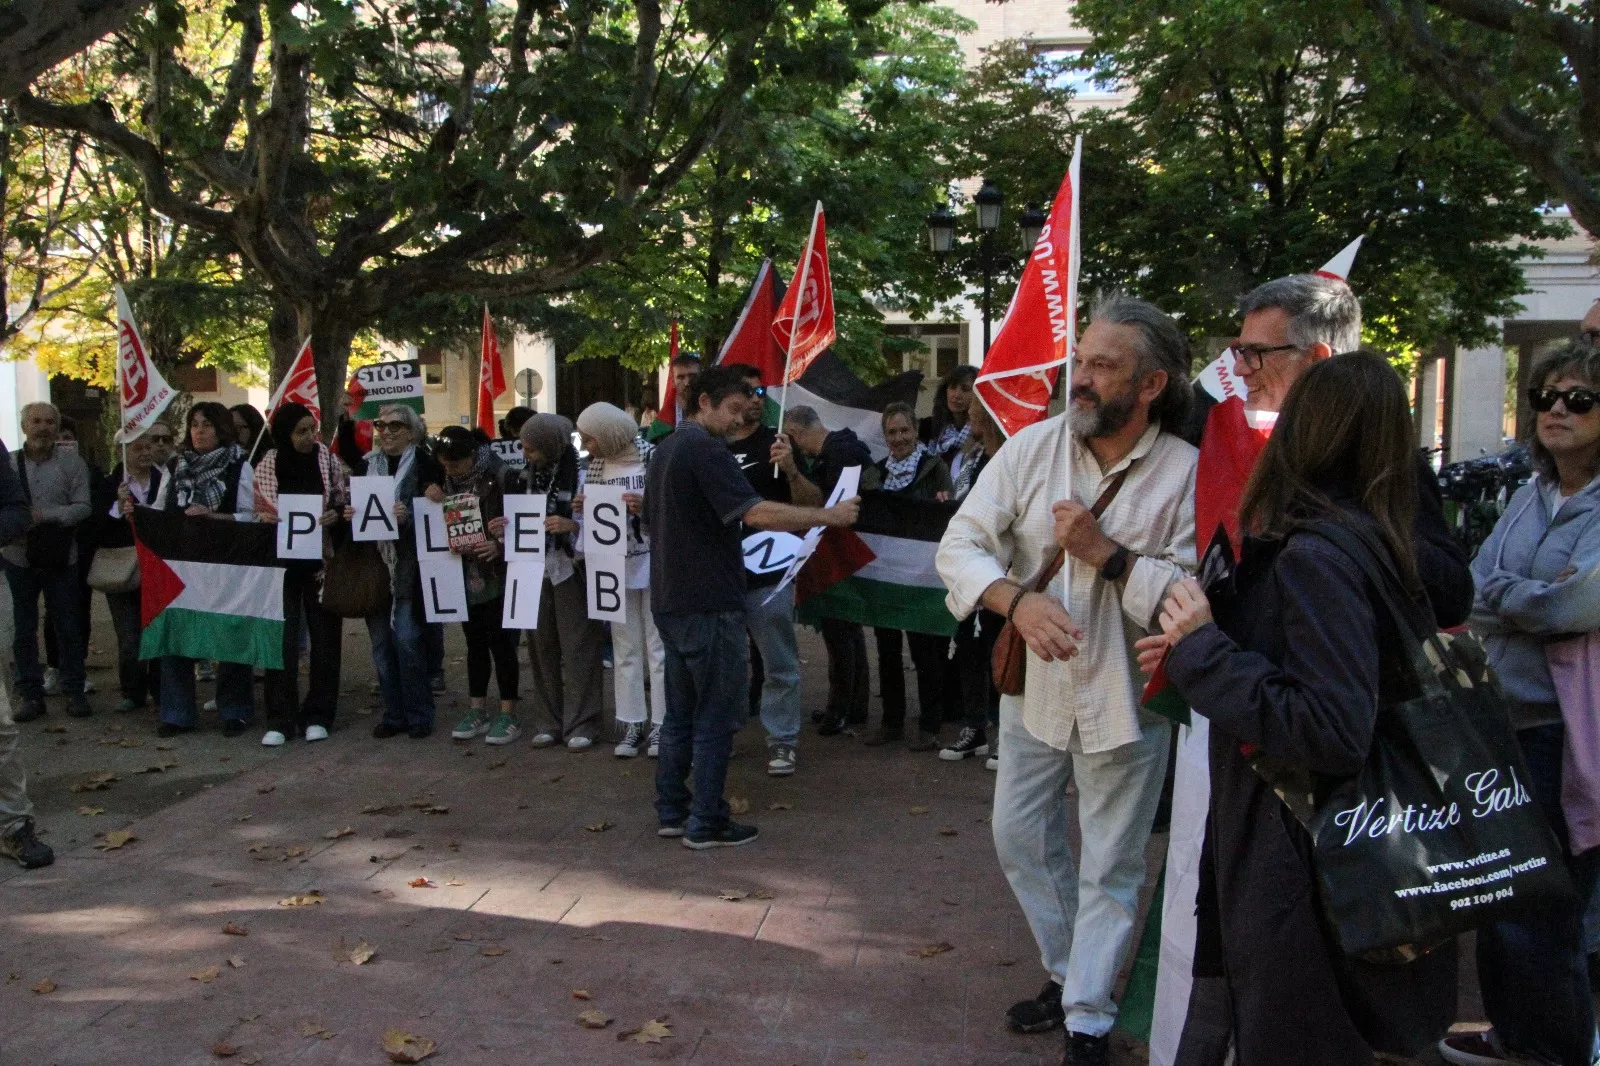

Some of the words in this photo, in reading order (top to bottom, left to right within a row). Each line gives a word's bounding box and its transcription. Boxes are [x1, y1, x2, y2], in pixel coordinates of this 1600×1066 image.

[358, 363, 412, 383] STOP
[489, 439, 526, 454] STO
[286, 511, 316, 550] P
[359, 493, 395, 533] A
[423, 514, 450, 553] L
[514, 512, 541, 554] E
[592, 502, 621, 546] S
[449, 520, 483, 537] STOP
[430, 577, 458, 615] L
[595, 570, 622, 613] B
[1334, 797, 1461, 847] Vertize
[1450, 897, 1471, 911] 902
[1473, 892, 1494, 906] 109
[1495, 886, 1514, 902] 904
